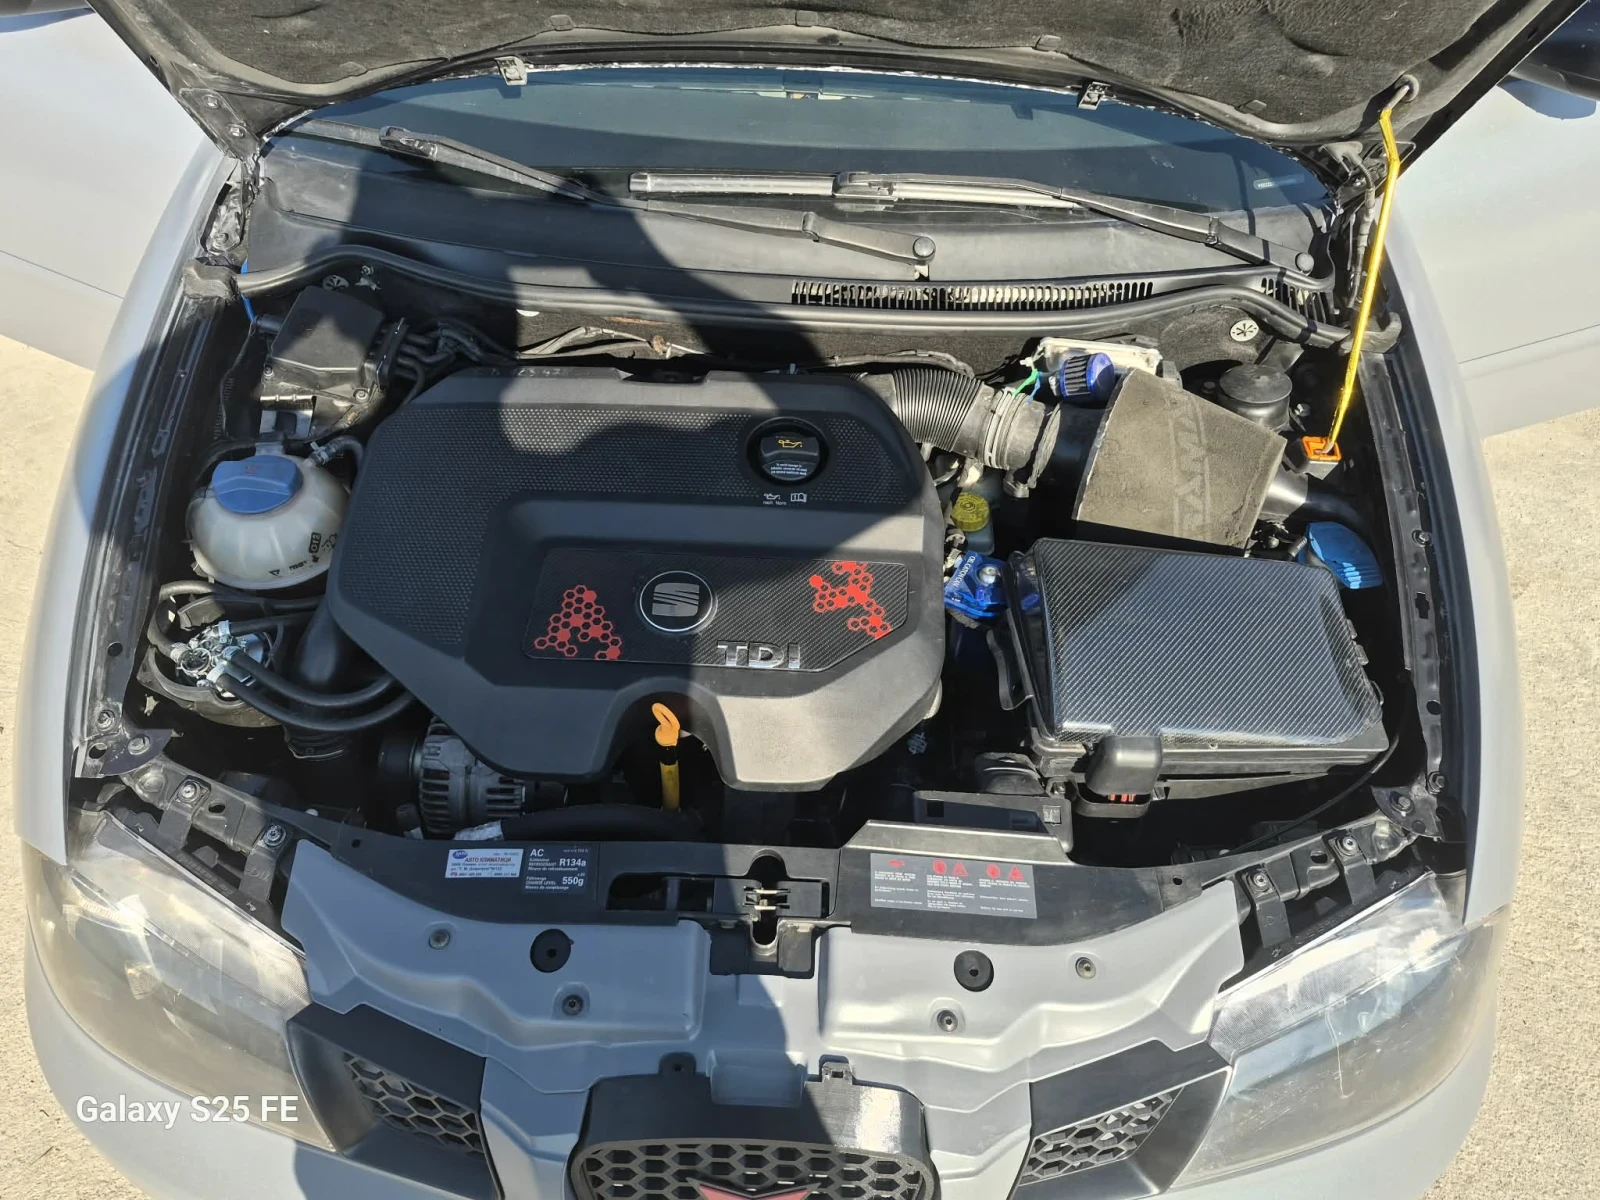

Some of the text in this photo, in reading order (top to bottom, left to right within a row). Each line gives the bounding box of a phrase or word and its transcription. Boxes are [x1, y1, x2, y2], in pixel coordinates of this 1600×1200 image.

[717, 640, 801, 670] TDI
[530, 849, 544, 857] AC
[559, 858, 587, 867] R134a
[562, 876, 584, 887] 550g
